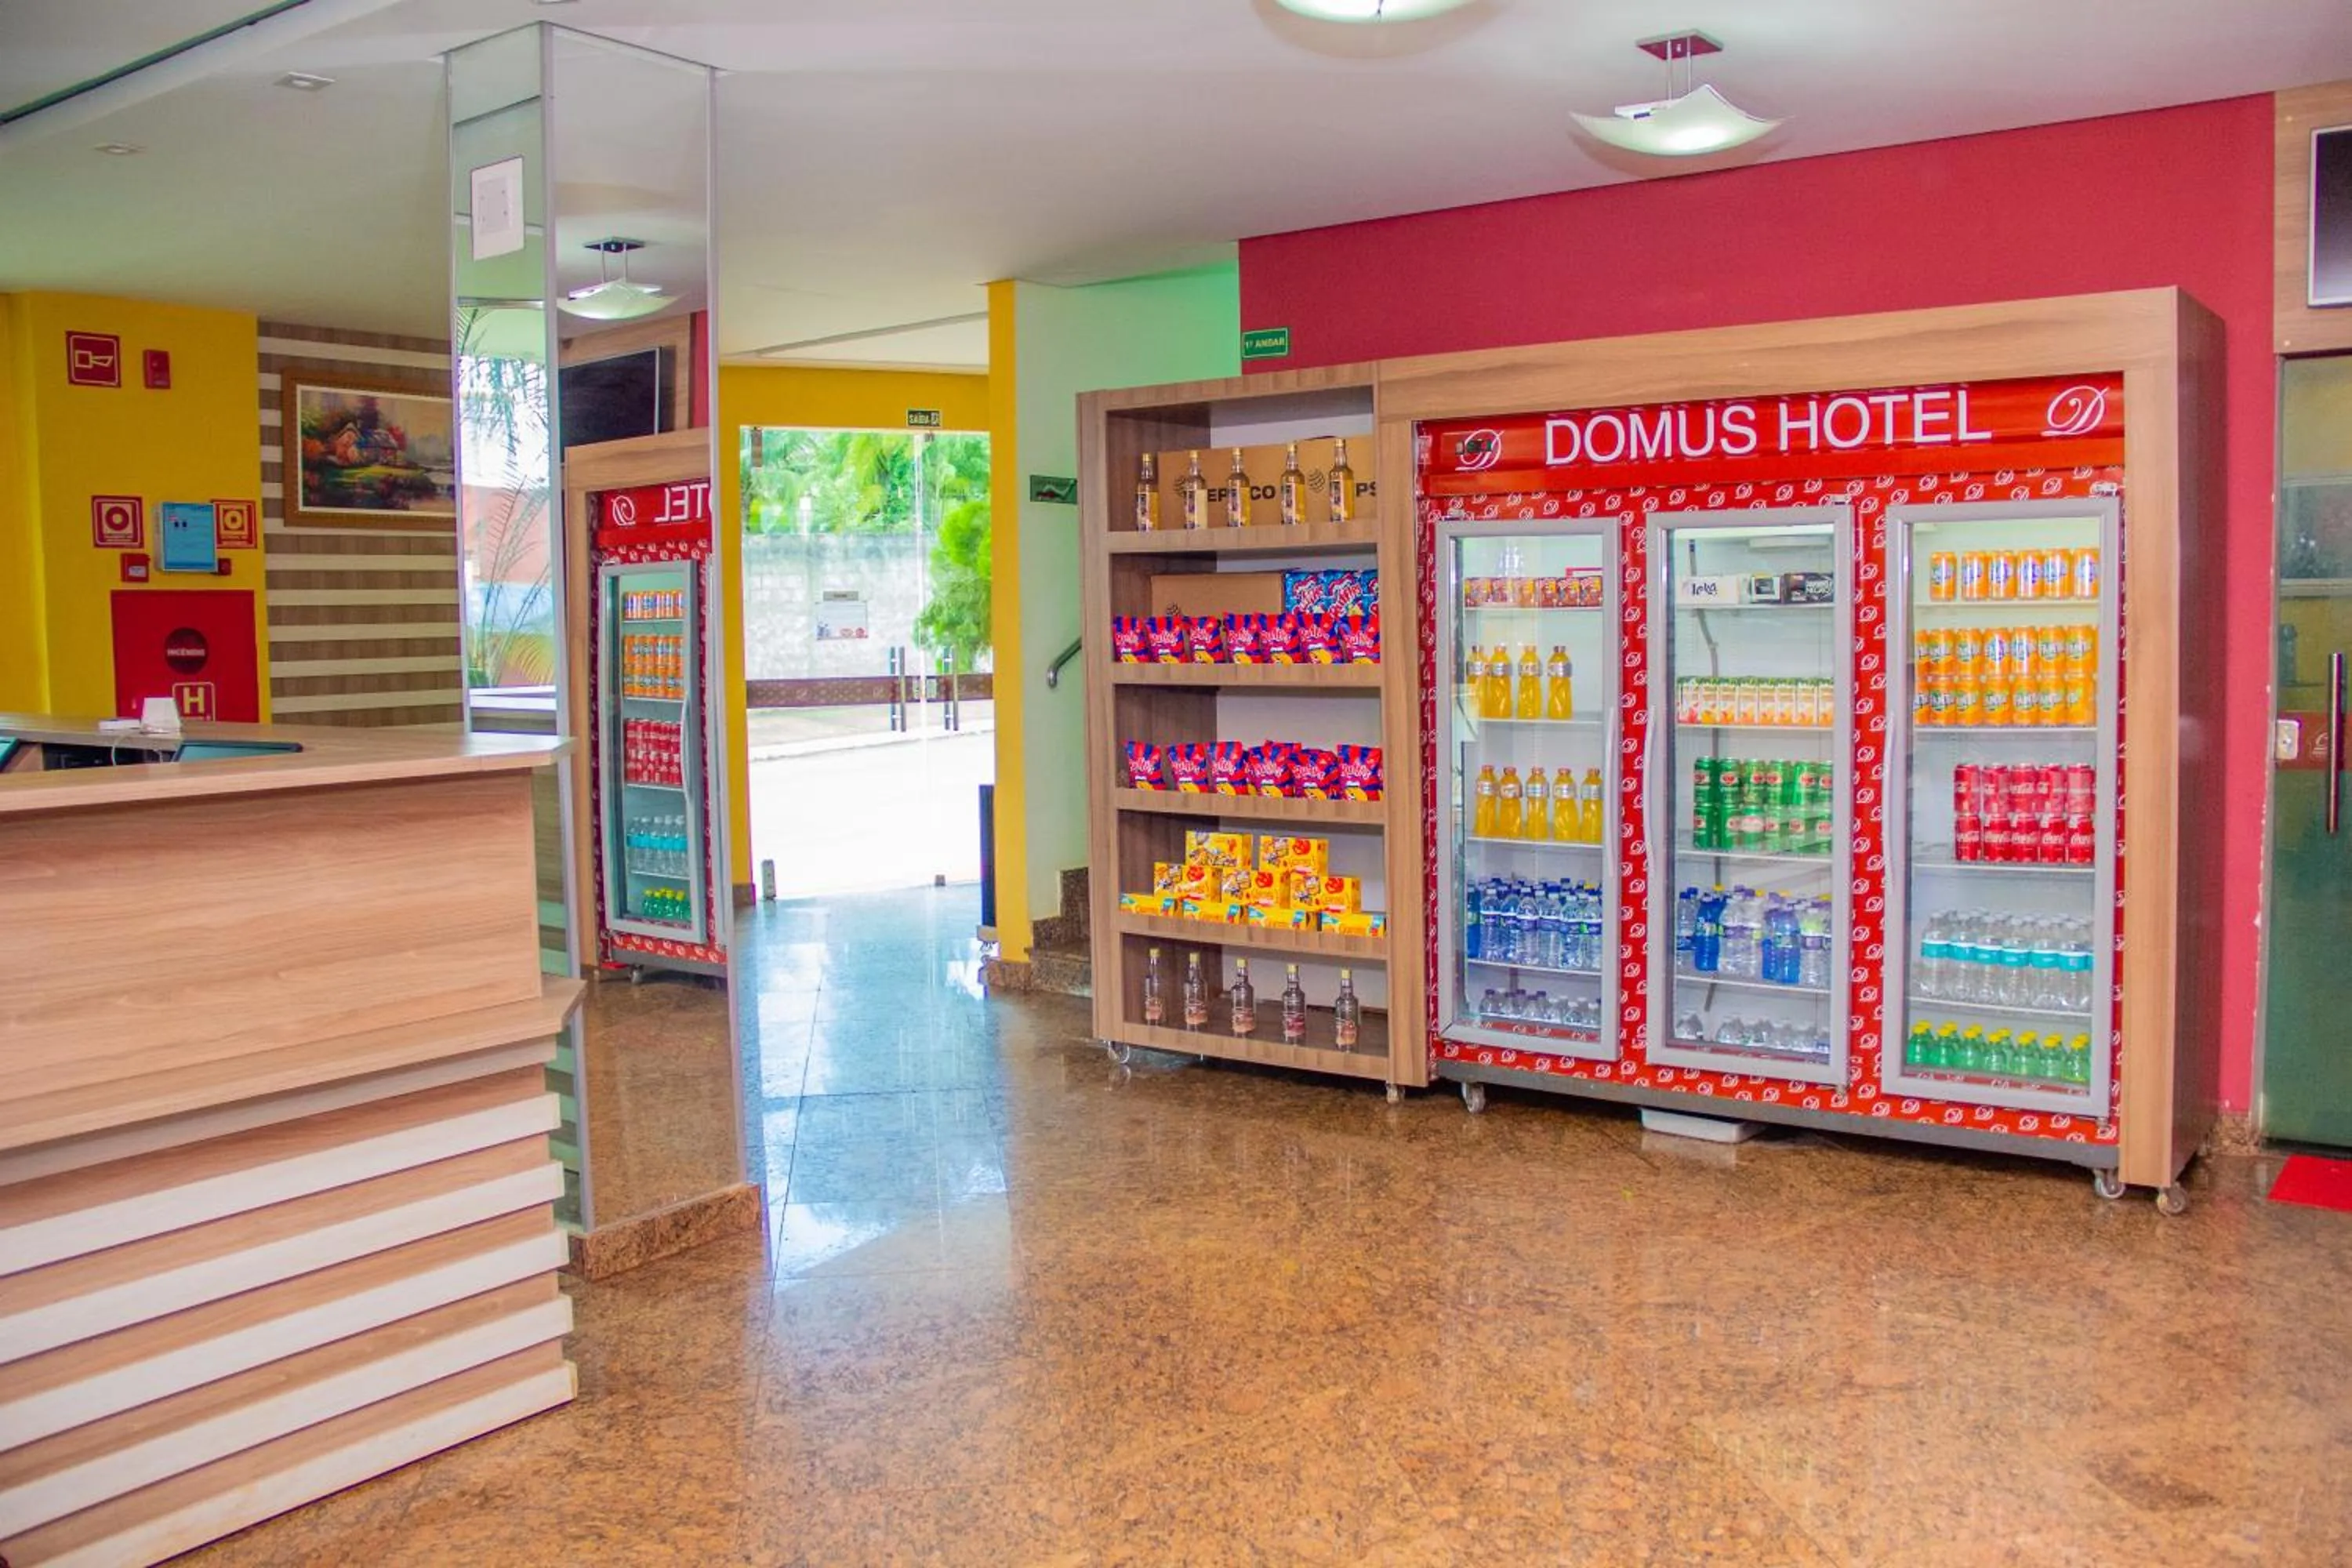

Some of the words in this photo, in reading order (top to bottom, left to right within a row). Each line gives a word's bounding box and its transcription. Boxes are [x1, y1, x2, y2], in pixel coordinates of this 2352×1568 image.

[1544, 405, 1758, 466] DOMUS
[1778, 390, 1993, 452] HOTEL
[183, 687, 205, 714] H
